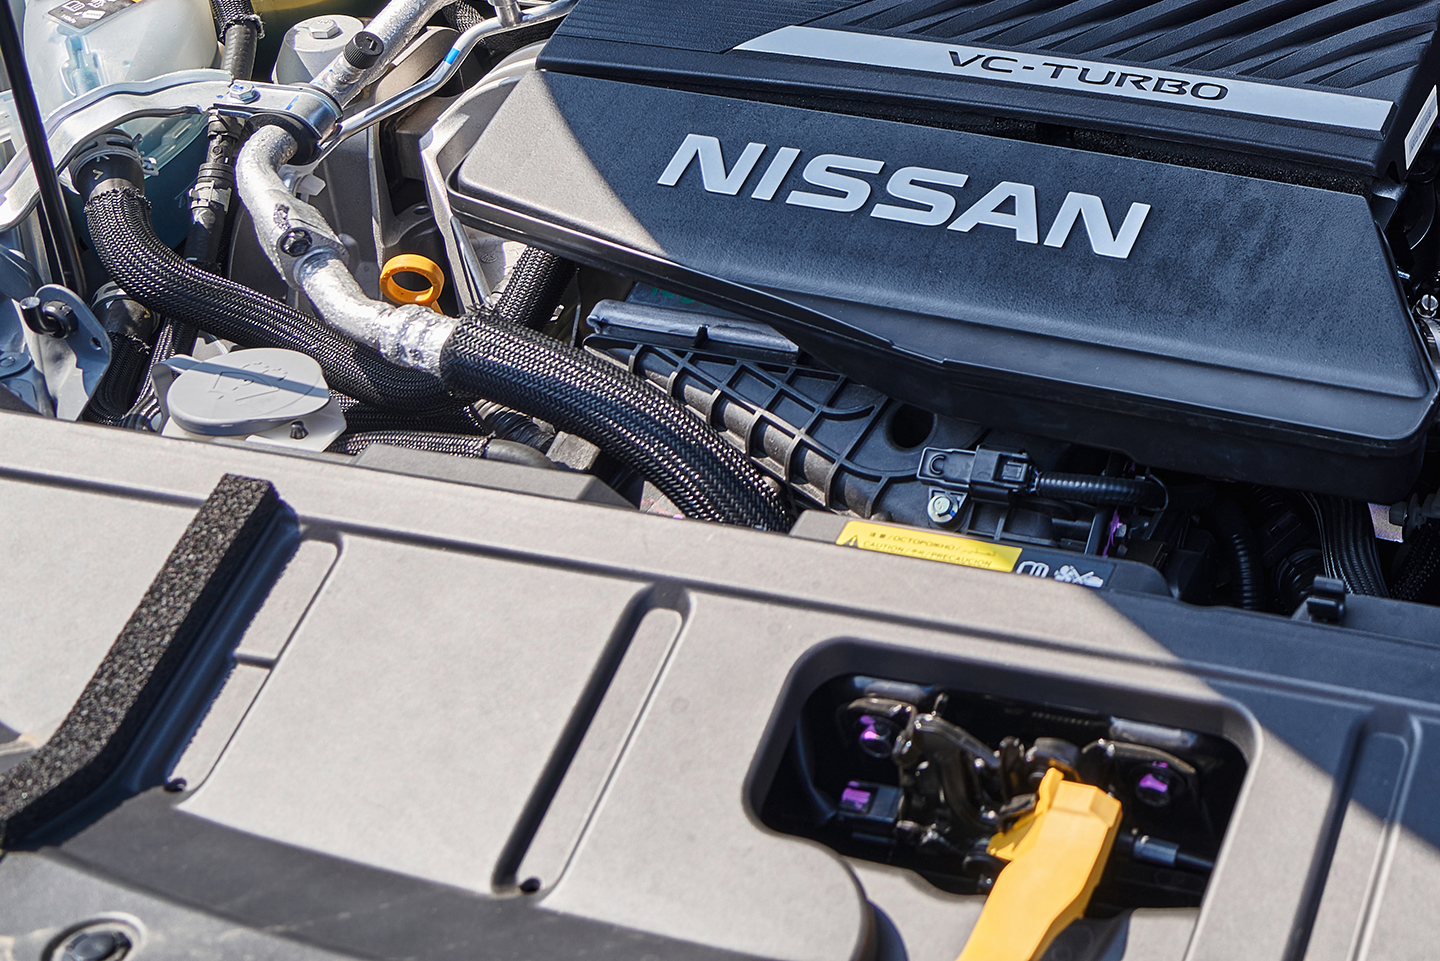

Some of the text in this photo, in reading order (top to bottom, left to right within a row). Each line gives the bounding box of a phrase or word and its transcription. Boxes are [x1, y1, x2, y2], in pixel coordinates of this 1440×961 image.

[947, 51, 1229, 101] VC-TURBO
[656, 132, 1152, 260] NISSAN
[863, 540, 904, 553] CAUTION
